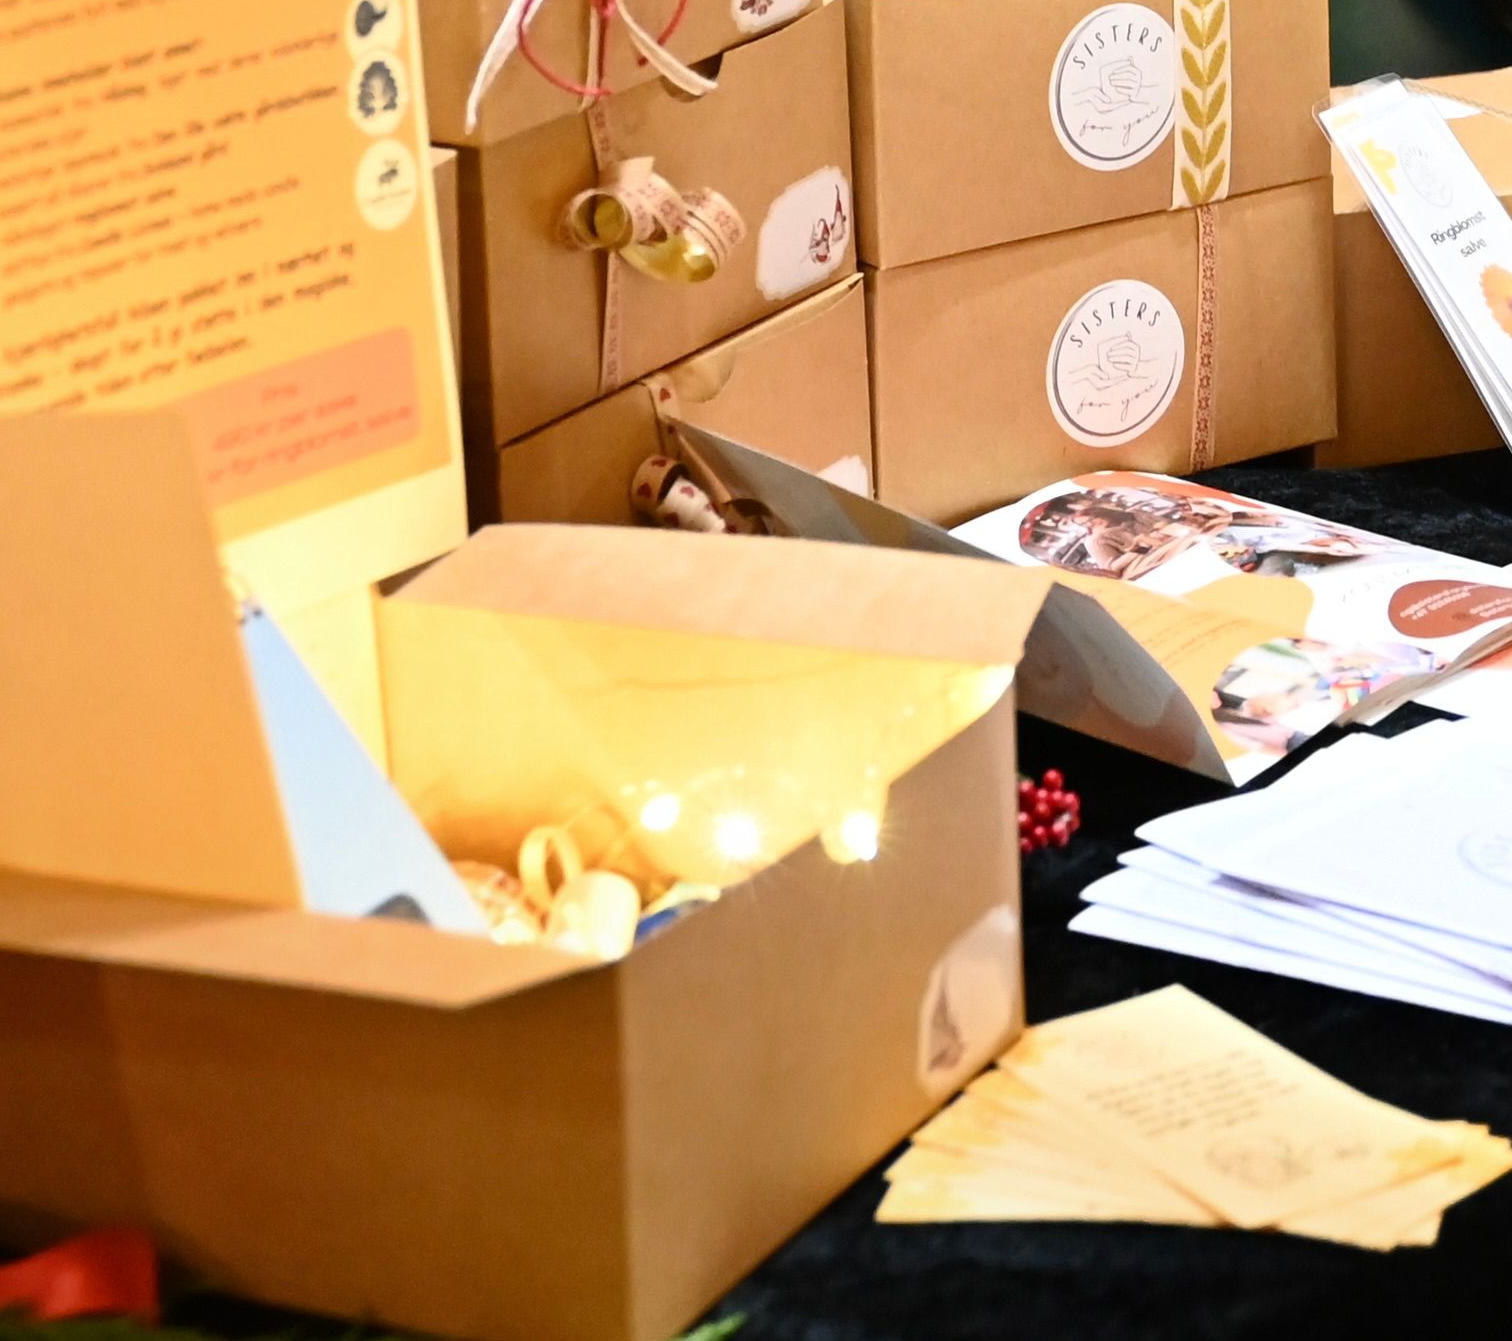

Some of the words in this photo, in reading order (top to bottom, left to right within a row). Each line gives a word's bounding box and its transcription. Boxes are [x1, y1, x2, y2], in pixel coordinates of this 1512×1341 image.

[1073, 23, 1162, 69] SISTERS
[1079, 119, 1113, 136] for
[1122, 106, 1160, 147] you
[1430, 211, 1487, 245] Ringblomst
[1460, 238, 1487, 257] salve
[1070, 299, 1160, 348] SISTERS
[1077, 398, 1111, 415] for
[1121, 379, 1158, 422] you
